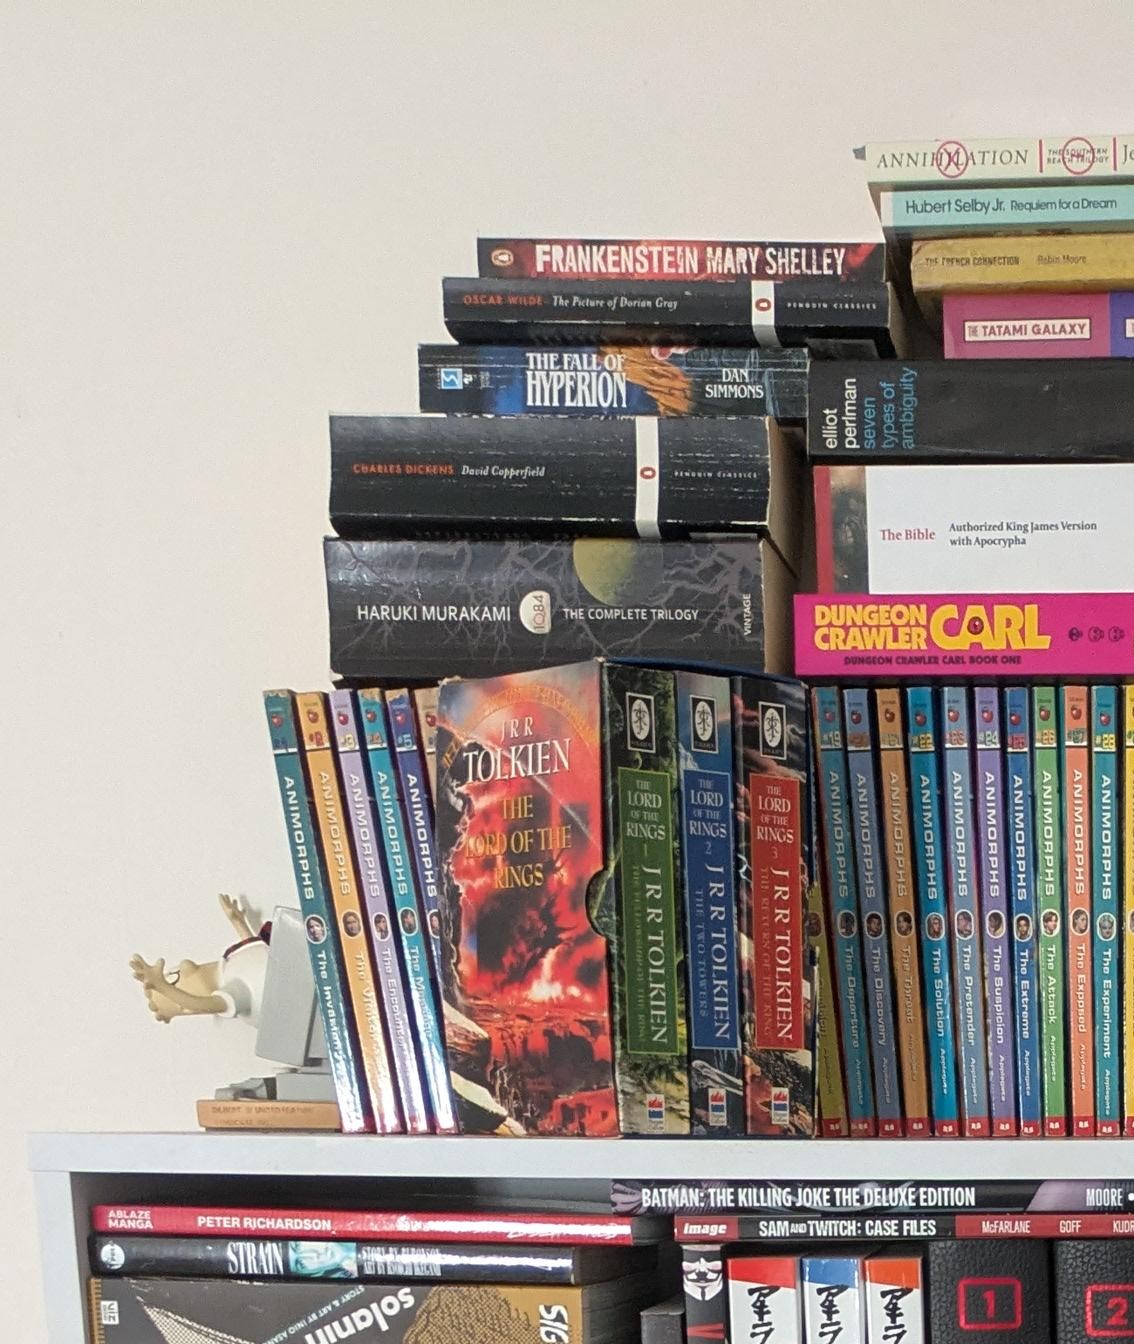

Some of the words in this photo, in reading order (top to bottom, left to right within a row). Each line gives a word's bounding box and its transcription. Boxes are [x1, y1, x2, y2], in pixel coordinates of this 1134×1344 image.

[906, 198, 951, 214] Hubert
[954, 198, 989, 214] Selby
[535, 244, 698, 274] FRANKENSTEIN
[706, 248, 758, 274] MARY
[765, 248, 845, 275] SHELLEY
[982, 322, 1028, 338] TATAMI
[1032, 321, 1087, 337] GALAXY
[526, 353, 559, 371] THE
[563, 353, 598, 370] FALL
[603, 354, 625, 371] OF
[722, 369, 749, 383] DAN
[526, 372, 627, 408] HYPERION
[705, 383, 764, 399] SIMMONS
[843, 378, 858, 449] perlman
[900, 367, 916, 449] ambiguity
[824, 408, 838, 449] elliot
[863, 396, 875, 449] seven
[493, 465, 545, 478] Copperfield
[881, 529, 901, 541] The
[905, 528, 935, 541] Bible
[949, 521, 1003, 532] Authorized
[1006, 521, 1027, 535] King
[1030, 520, 1058, 532] James
[1061, 520, 1097, 531] Version
[357, 605, 418, 622] HARUKI
[421, 606, 511, 623] MURAKAMI
[651, 608, 698, 622] TRILOGY
[815, 603, 928, 628] DUNGEON
[930, 603, 1052, 649] CARL
[815, 625, 928, 651] CRAWLER
[463, 740, 571, 784] TOLKIEN
[627, 793, 662, 809] LORD
[284, 776, 314, 900] ANIMORPHS
[626, 823, 666, 840] RINGS
[920, 775, 938, 899] ANIMORPHS
[646, 932, 668, 1044] TOLKIEN
[1046, 975, 1056, 1024] Attack
[641, 1187, 704, 1208] BATMAN:
[738, 1187, 790, 1207] KILLING
[795, 1188, 831, 1207] JOKE
[866, 1187, 913, 1206] DELUXE
[915, 1187, 976, 1206] EDITION
[197, 1215, 242, 1230] PETER
[244, 1216, 332, 1233] RICHARDSON
[864, 1219, 901, 1236] CASE
[904, 1219, 937, 1236] FILES
